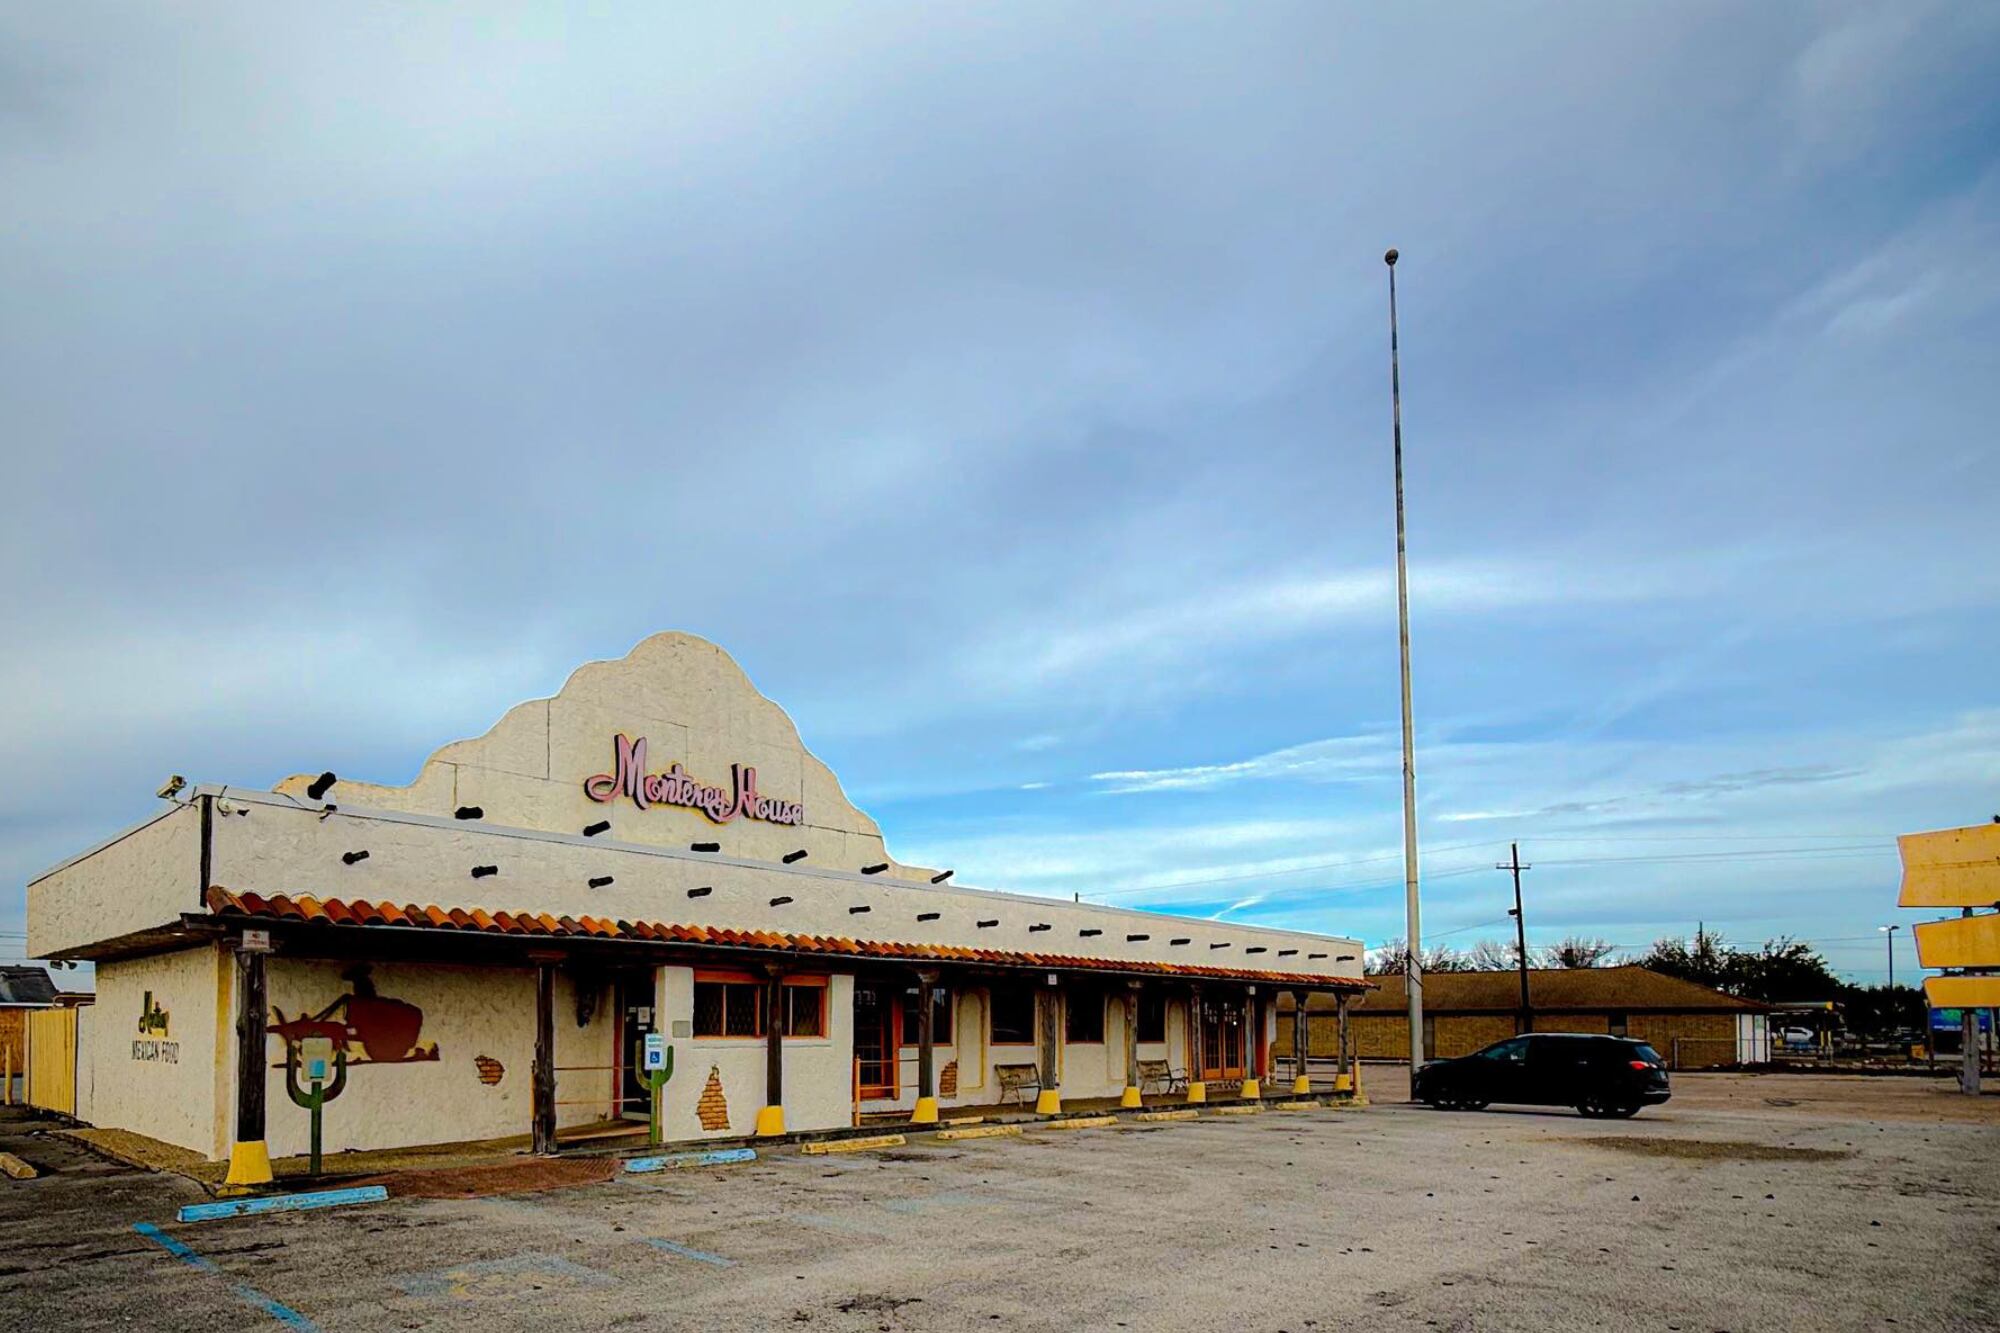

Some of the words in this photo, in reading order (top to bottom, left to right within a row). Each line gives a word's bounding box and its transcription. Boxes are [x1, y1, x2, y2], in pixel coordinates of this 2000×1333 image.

[584, 733, 732, 821] Monterey
[711, 763, 804, 825] House
[131, 1040, 159, 1061] MEXICAN
[162, 1041, 180, 1064] FOOD
